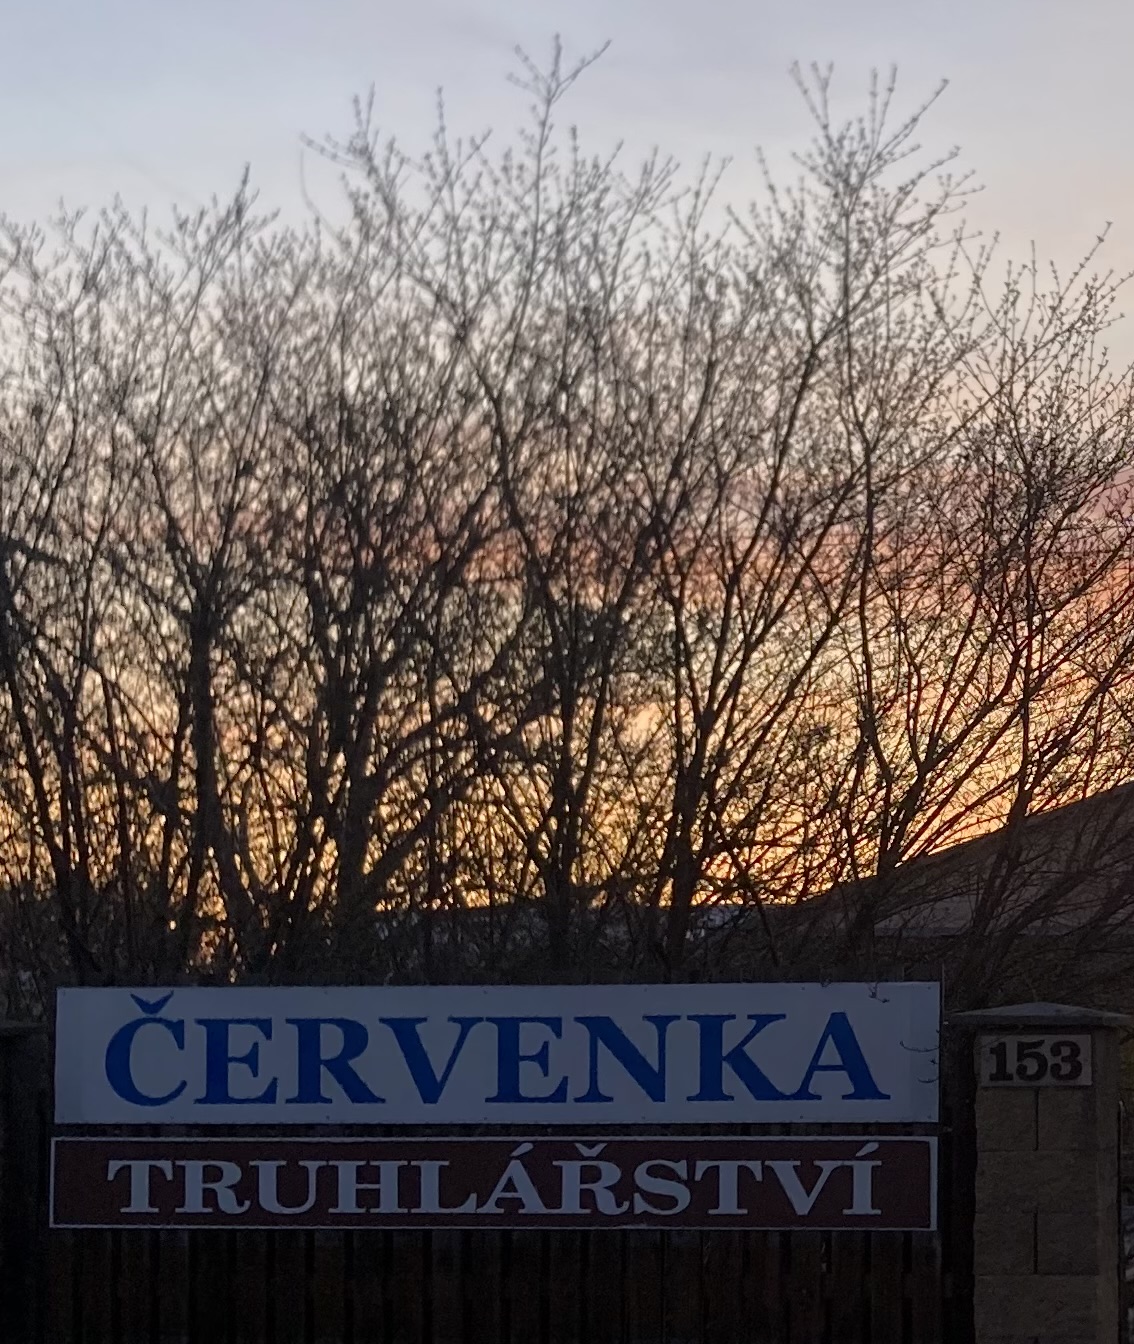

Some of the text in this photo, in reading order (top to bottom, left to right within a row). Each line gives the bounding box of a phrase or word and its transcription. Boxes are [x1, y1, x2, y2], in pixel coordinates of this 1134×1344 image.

[105, 990, 891, 1106] ČERVENKA
[988, 1039, 1083, 1082] 153
[107, 1142, 883, 1216] TRUHLÁŘSTVÍ
